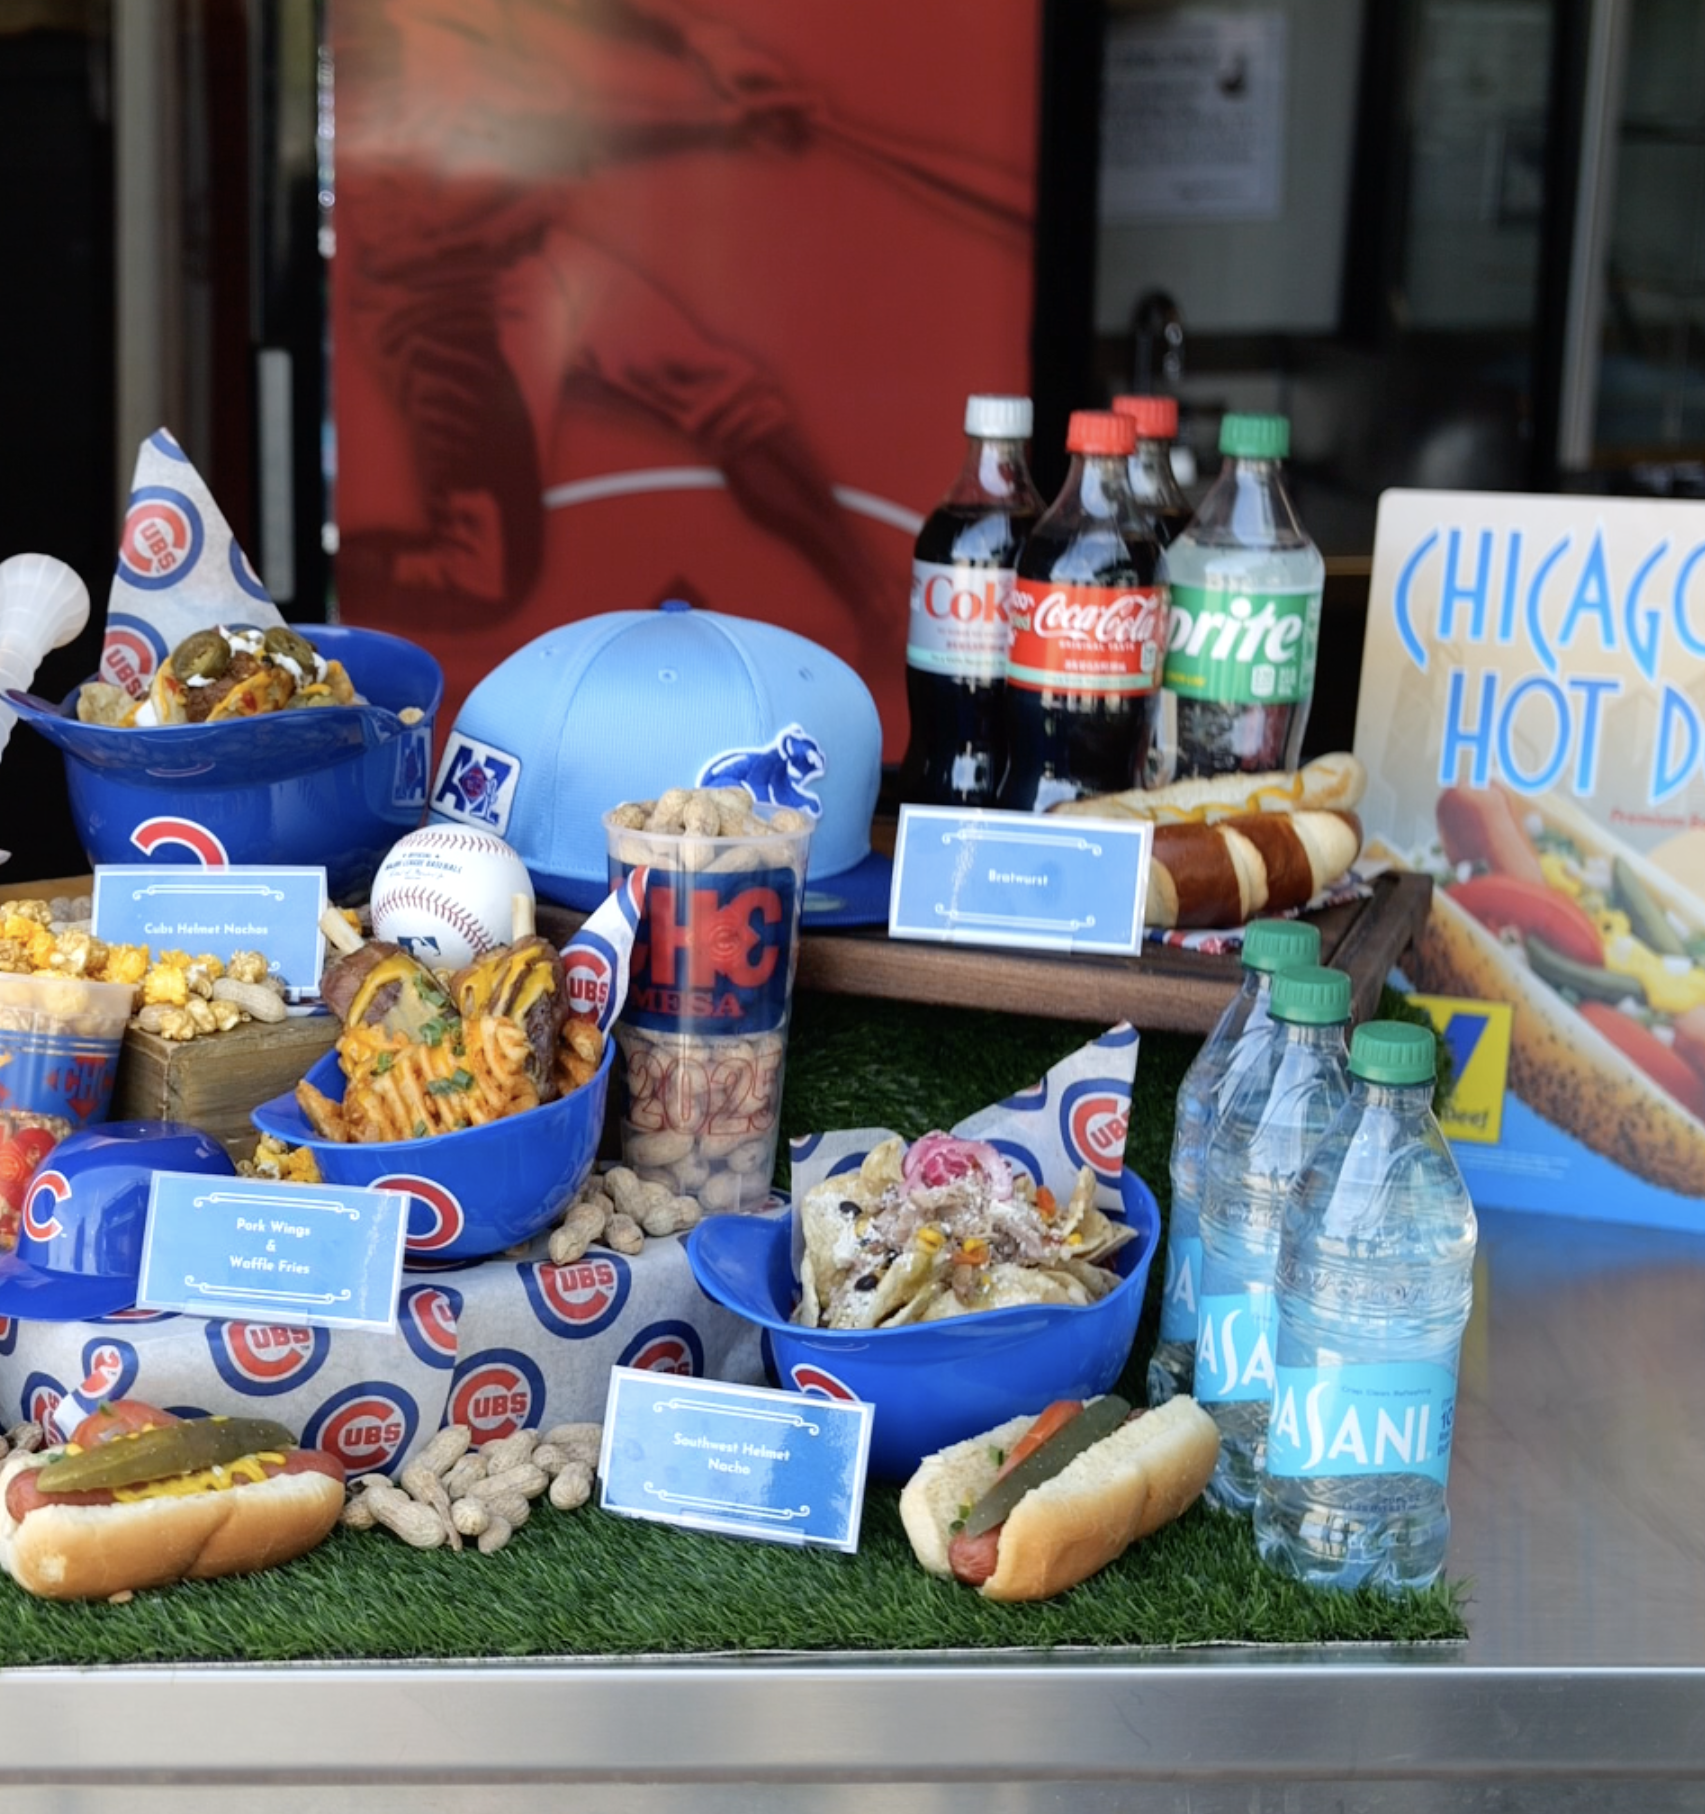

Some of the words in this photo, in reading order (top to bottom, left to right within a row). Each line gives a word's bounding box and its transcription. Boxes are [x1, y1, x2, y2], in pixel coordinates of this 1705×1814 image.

[924, 574, 1010, 625] Cok
[1033, 591, 1157, 643] Coca-Cola
[1168, 596, 1303, 664] prite
[1439, 670, 1621, 796] HOT
[1649, 685, 1705, 806] D
[988, 868, 1049, 888] Bratwurst
[144, 922, 180, 936] Cubs
[183, 922, 222, 936] Helmet
[225, 922, 269, 936] Nachos
[626, 1047, 783, 1137] 2025
[236, 1216, 266, 1234] Pork
[269, 1218, 311, 1239] Wings
[265, 1239, 277, 1253] &
[229, 1255, 274, 1272] Waffle
[278, 1260, 311, 1276] Fries
[672, 1431, 738, 1457] Southwest
[742, 1440, 791, 1464] Helmet
[707, 1456, 751, 1477] Nacho
